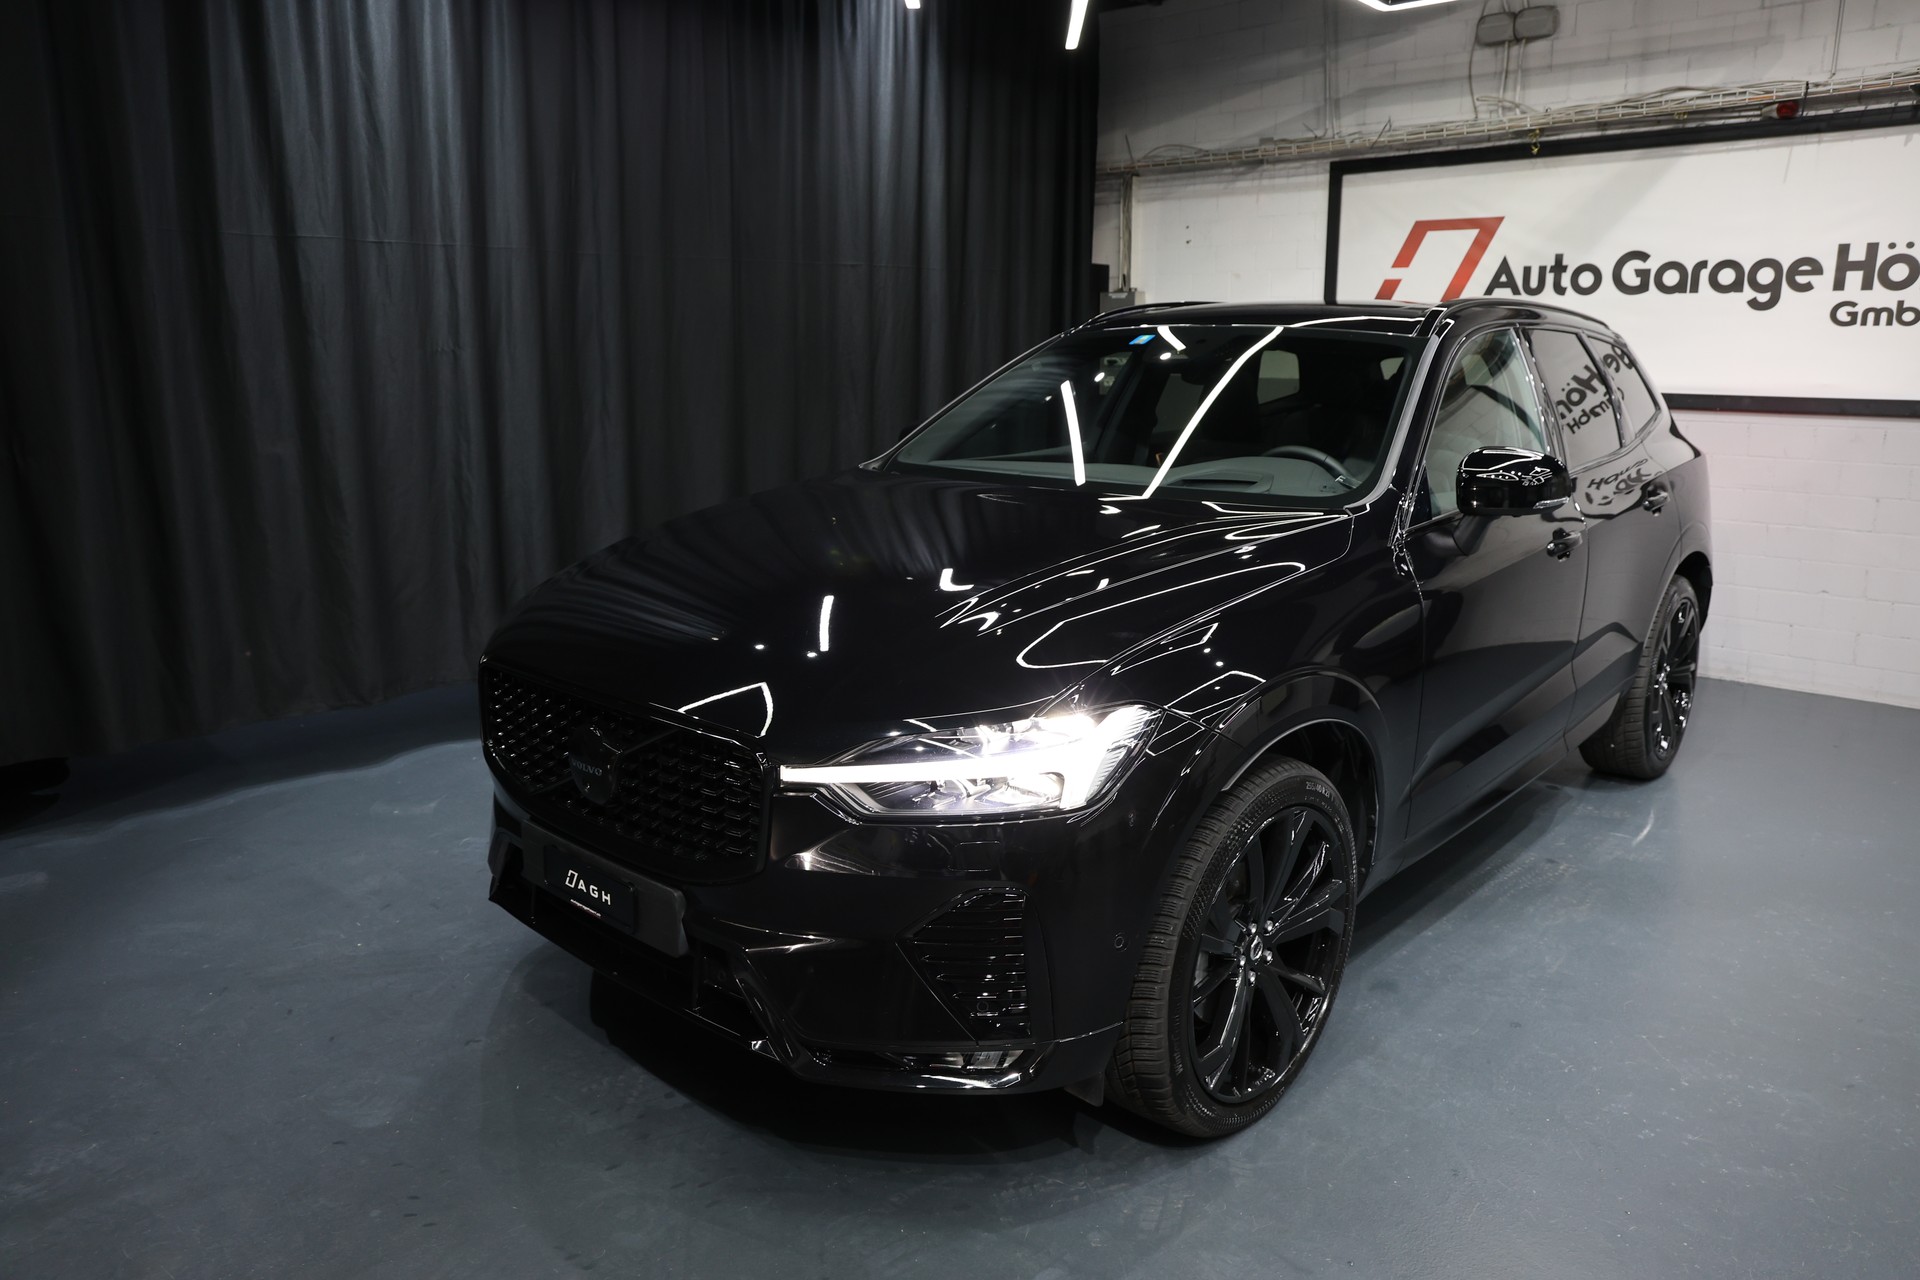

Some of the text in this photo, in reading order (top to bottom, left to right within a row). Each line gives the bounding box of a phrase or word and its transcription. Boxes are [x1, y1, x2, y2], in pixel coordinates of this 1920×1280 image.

[1484, 254, 1602, 296] Auto
[1612, 251, 1823, 311] Garage
[572, 758, 603, 777] VOLVO
[577, 879, 611, 905] AGH
